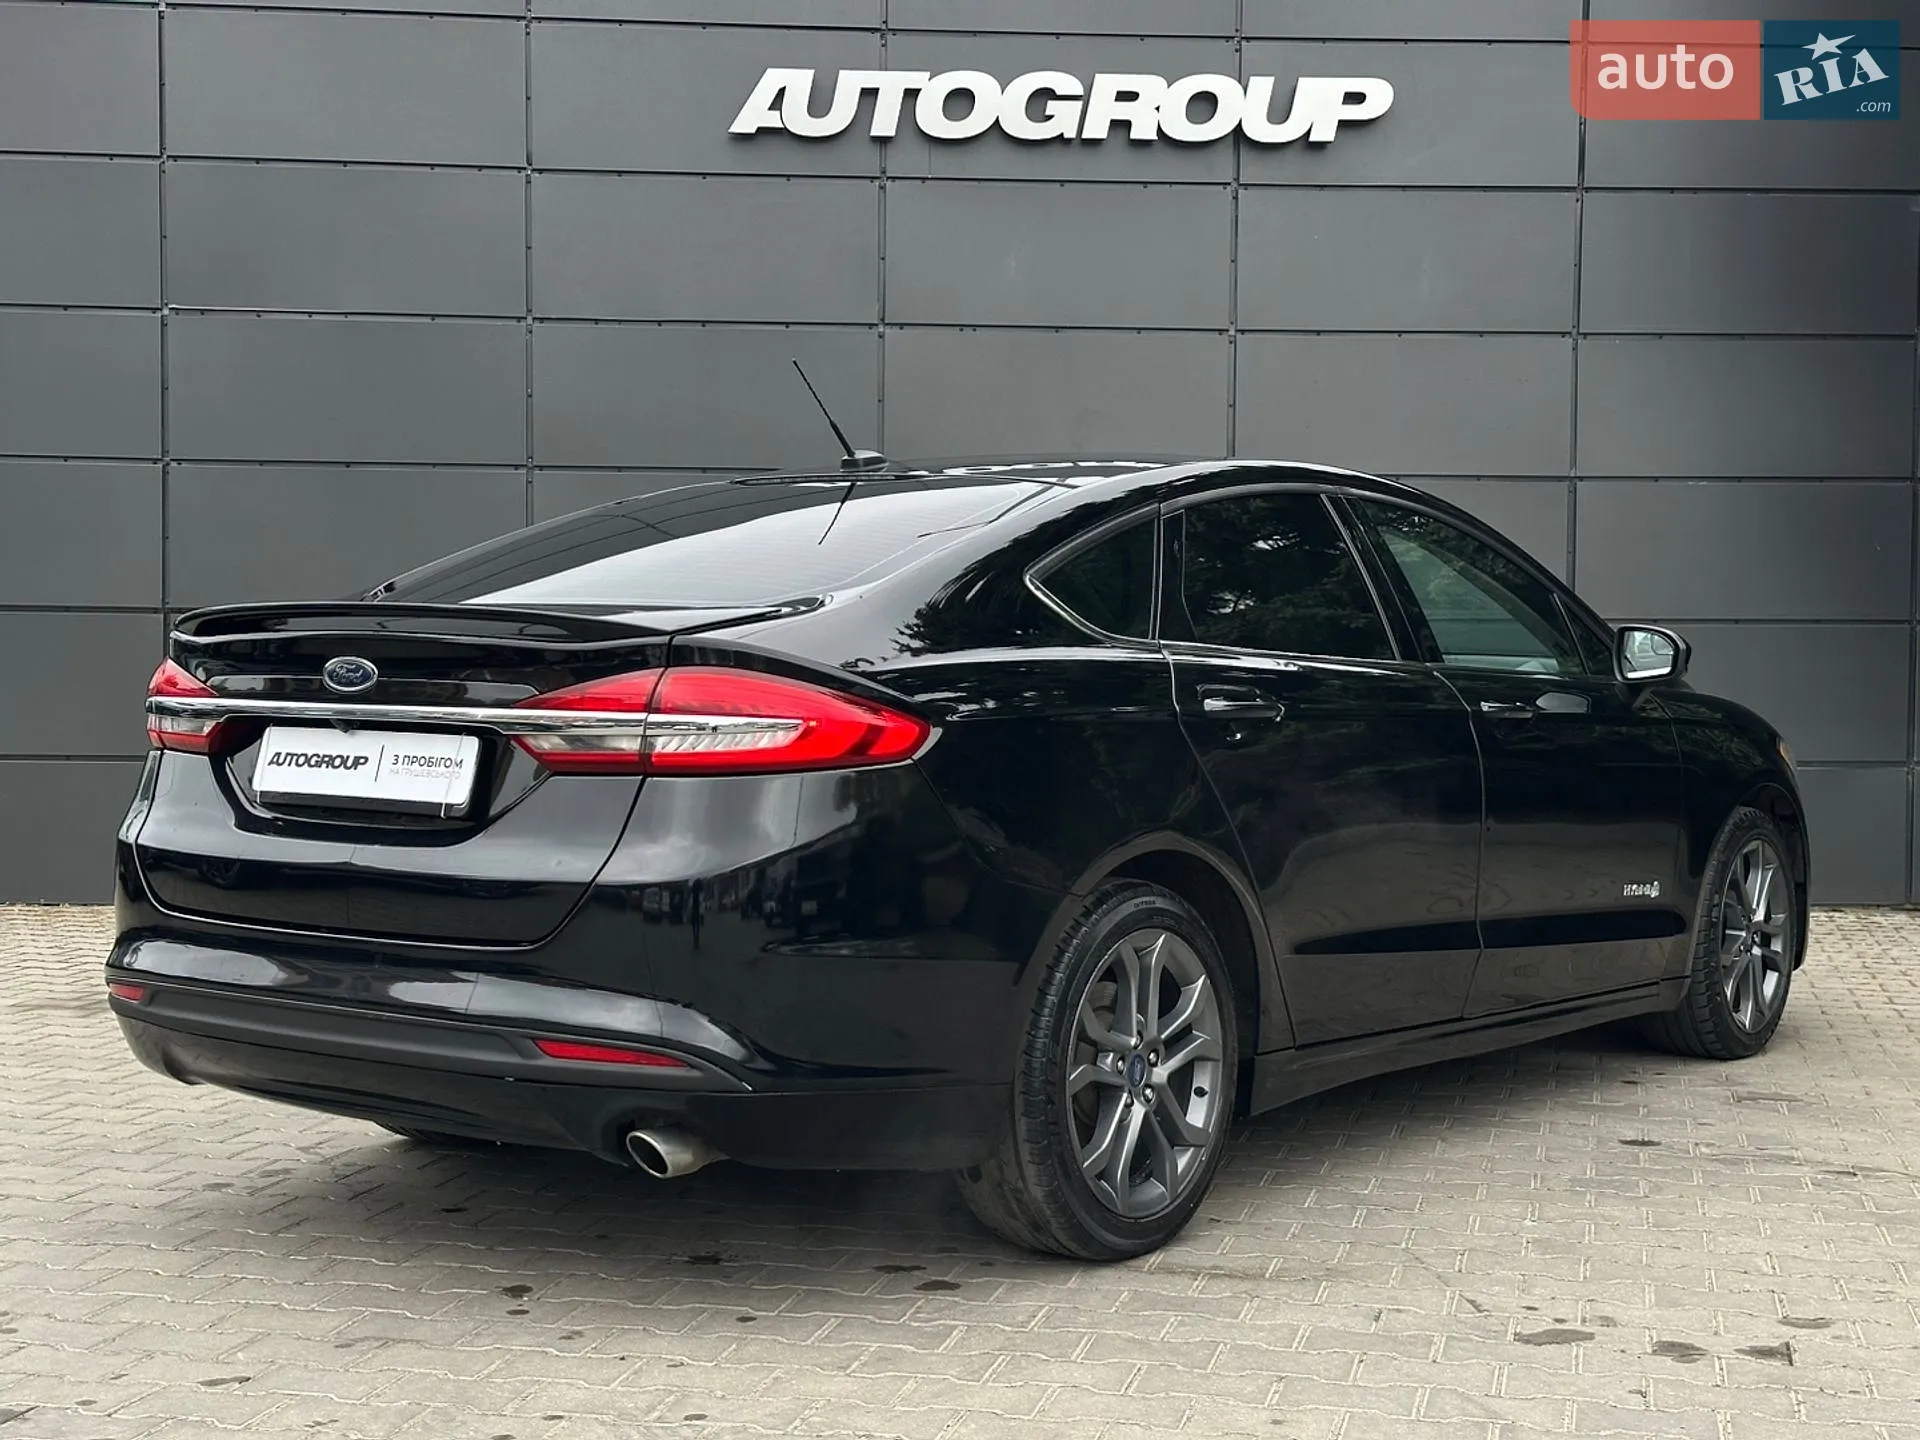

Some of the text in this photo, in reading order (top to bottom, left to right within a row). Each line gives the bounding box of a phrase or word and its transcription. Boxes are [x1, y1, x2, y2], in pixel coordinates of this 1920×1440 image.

[728, 67, 1395, 144] AUTOGROUP
[267, 751, 369, 771] AUTOGROUP
[402, 755, 464, 769] ПРОБІГОМ
